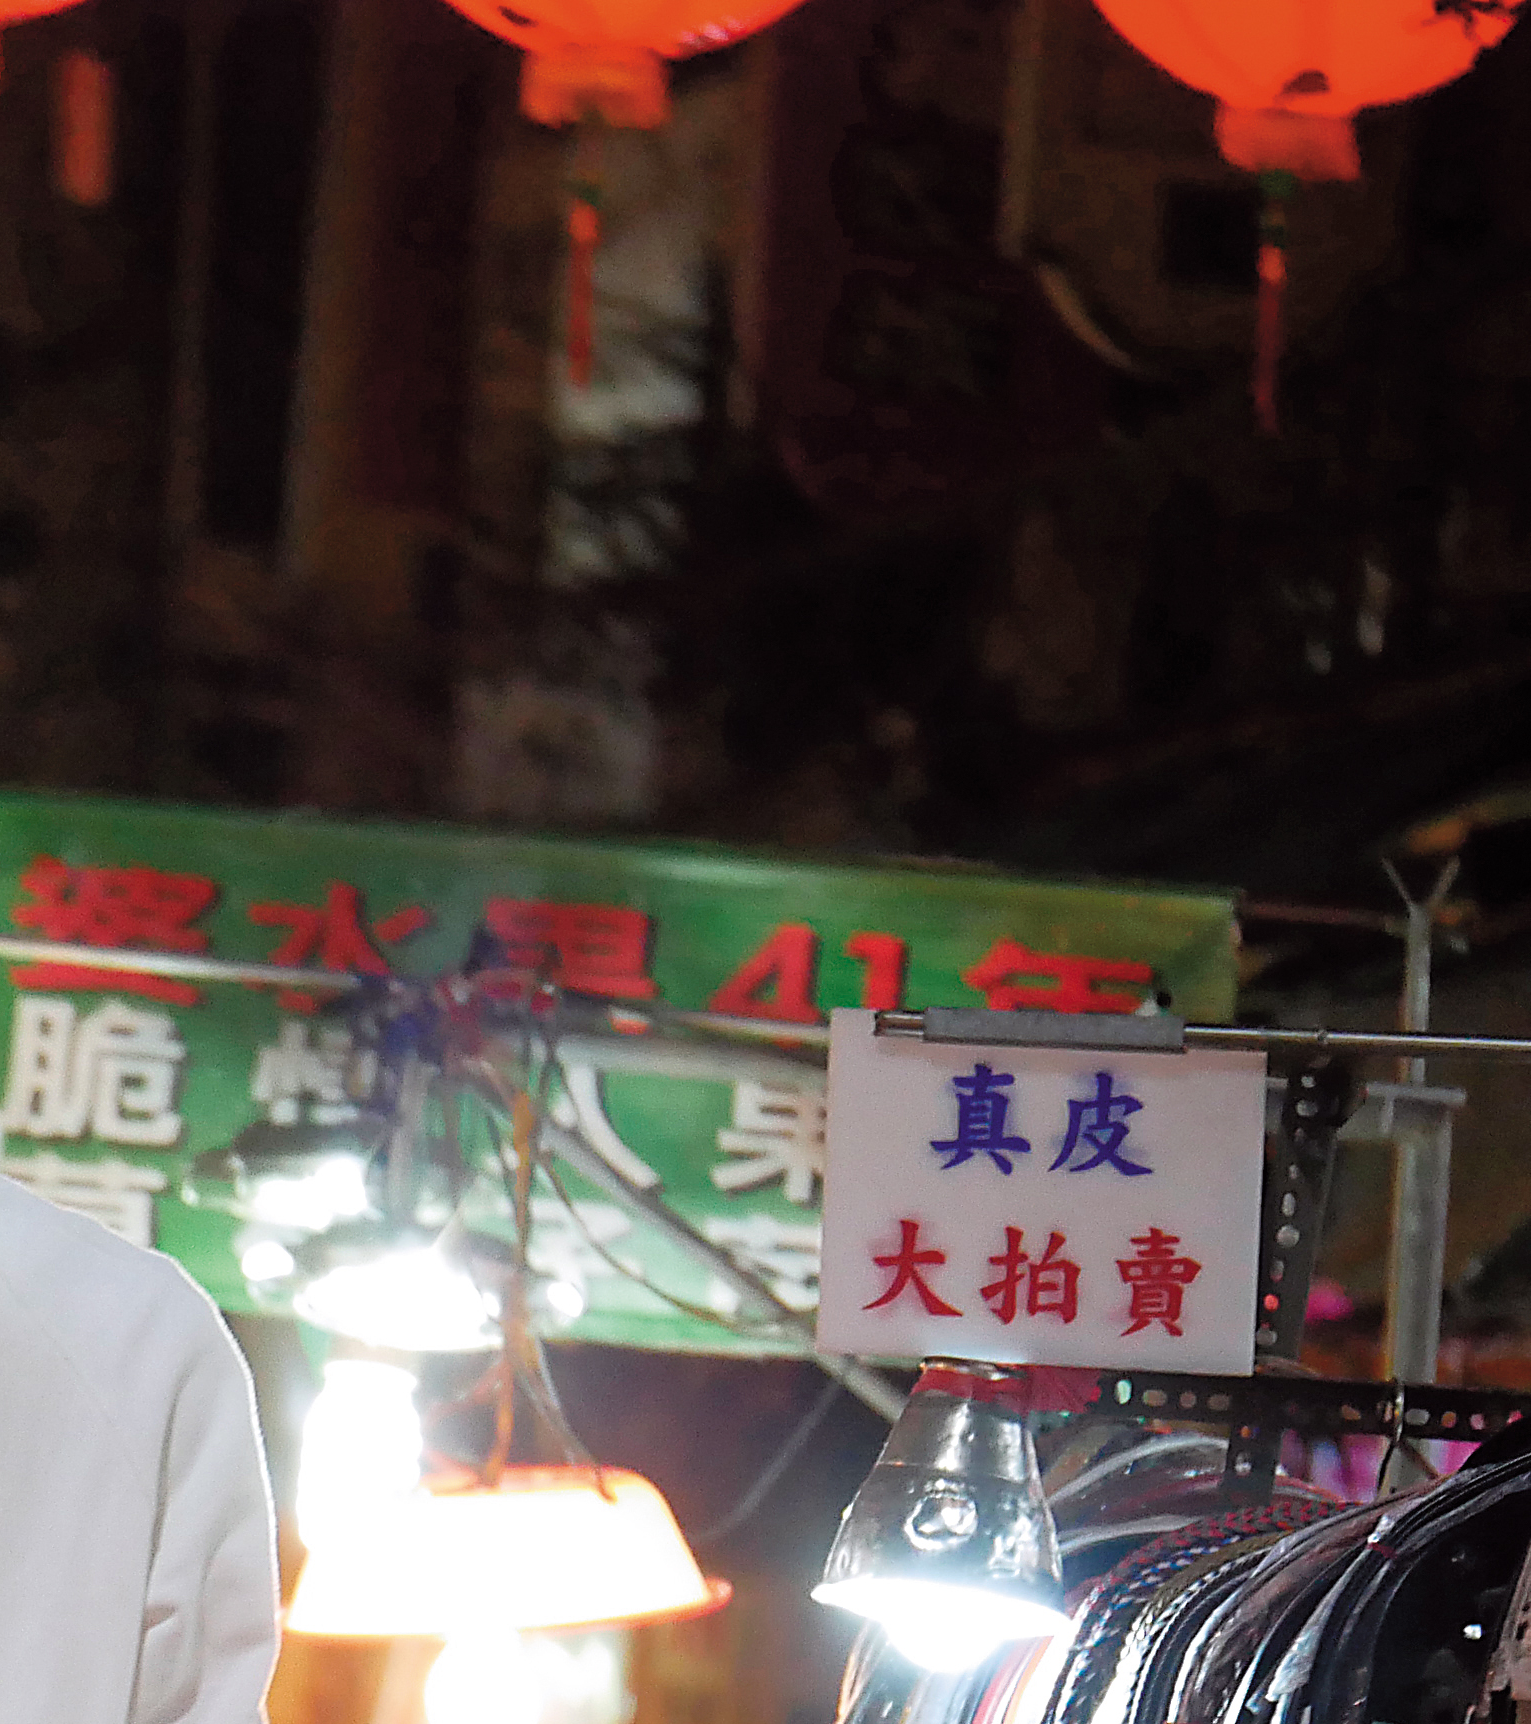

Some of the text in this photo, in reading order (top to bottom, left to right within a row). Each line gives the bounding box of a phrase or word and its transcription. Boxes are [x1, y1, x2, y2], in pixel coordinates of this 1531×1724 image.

[929, 1062, 1153, 1176] 真皮
[862, 1219, 1201, 1337] 大拍賣
